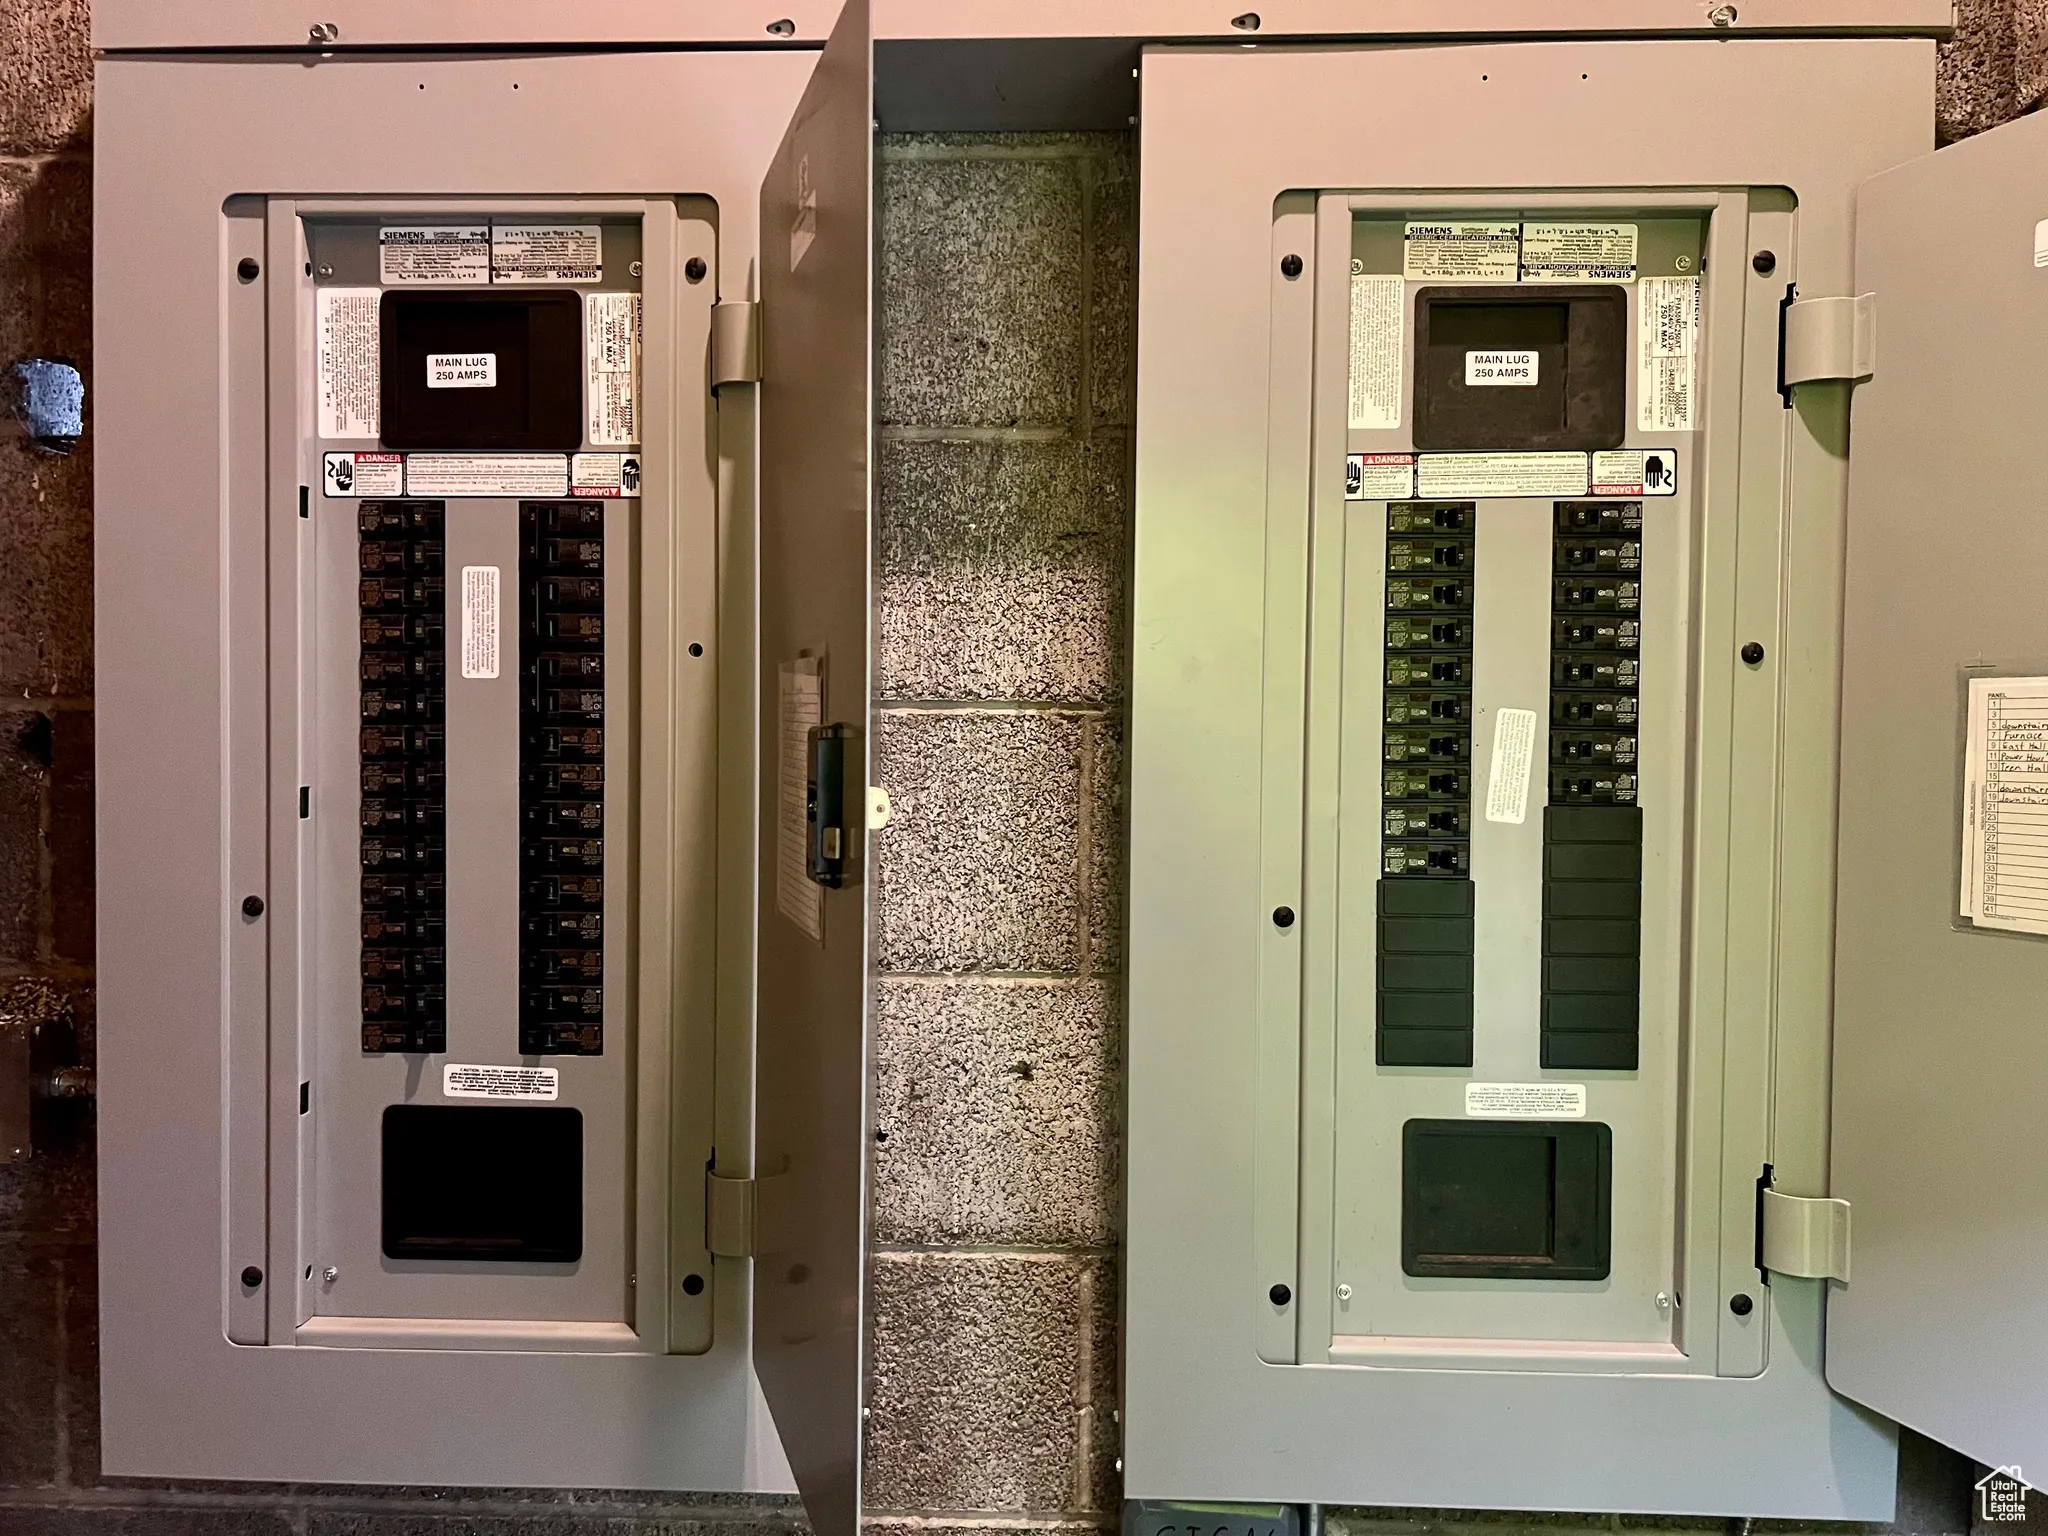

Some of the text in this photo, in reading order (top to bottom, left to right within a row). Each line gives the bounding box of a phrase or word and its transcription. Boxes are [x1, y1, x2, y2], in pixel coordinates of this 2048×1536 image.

[384, 231, 425, 239] SIEMENS
[1409, 227, 1452, 235] SIEMENS
[556, 271, 597, 279] SIEMENS
[1588, 270, 1631, 278] SIEMENS
[1660, 305, 1668, 319] 250
[435, 358, 488, 367] MAIN LUG
[1474, 354, 1530, 364] MAIN LUG
[436, 370, 487, 381] 250 AMPS
[1475, 367, 1529, 378] 250 AMPS
[365, 454, 401, 462] DANGER
[1376, 456, 1412, 464] DANGER
[574, 488, 610, 496] DANGER
[1594, 486, 1631, 494] DANGER
[2004, 730, 2042, 740] Furnace
